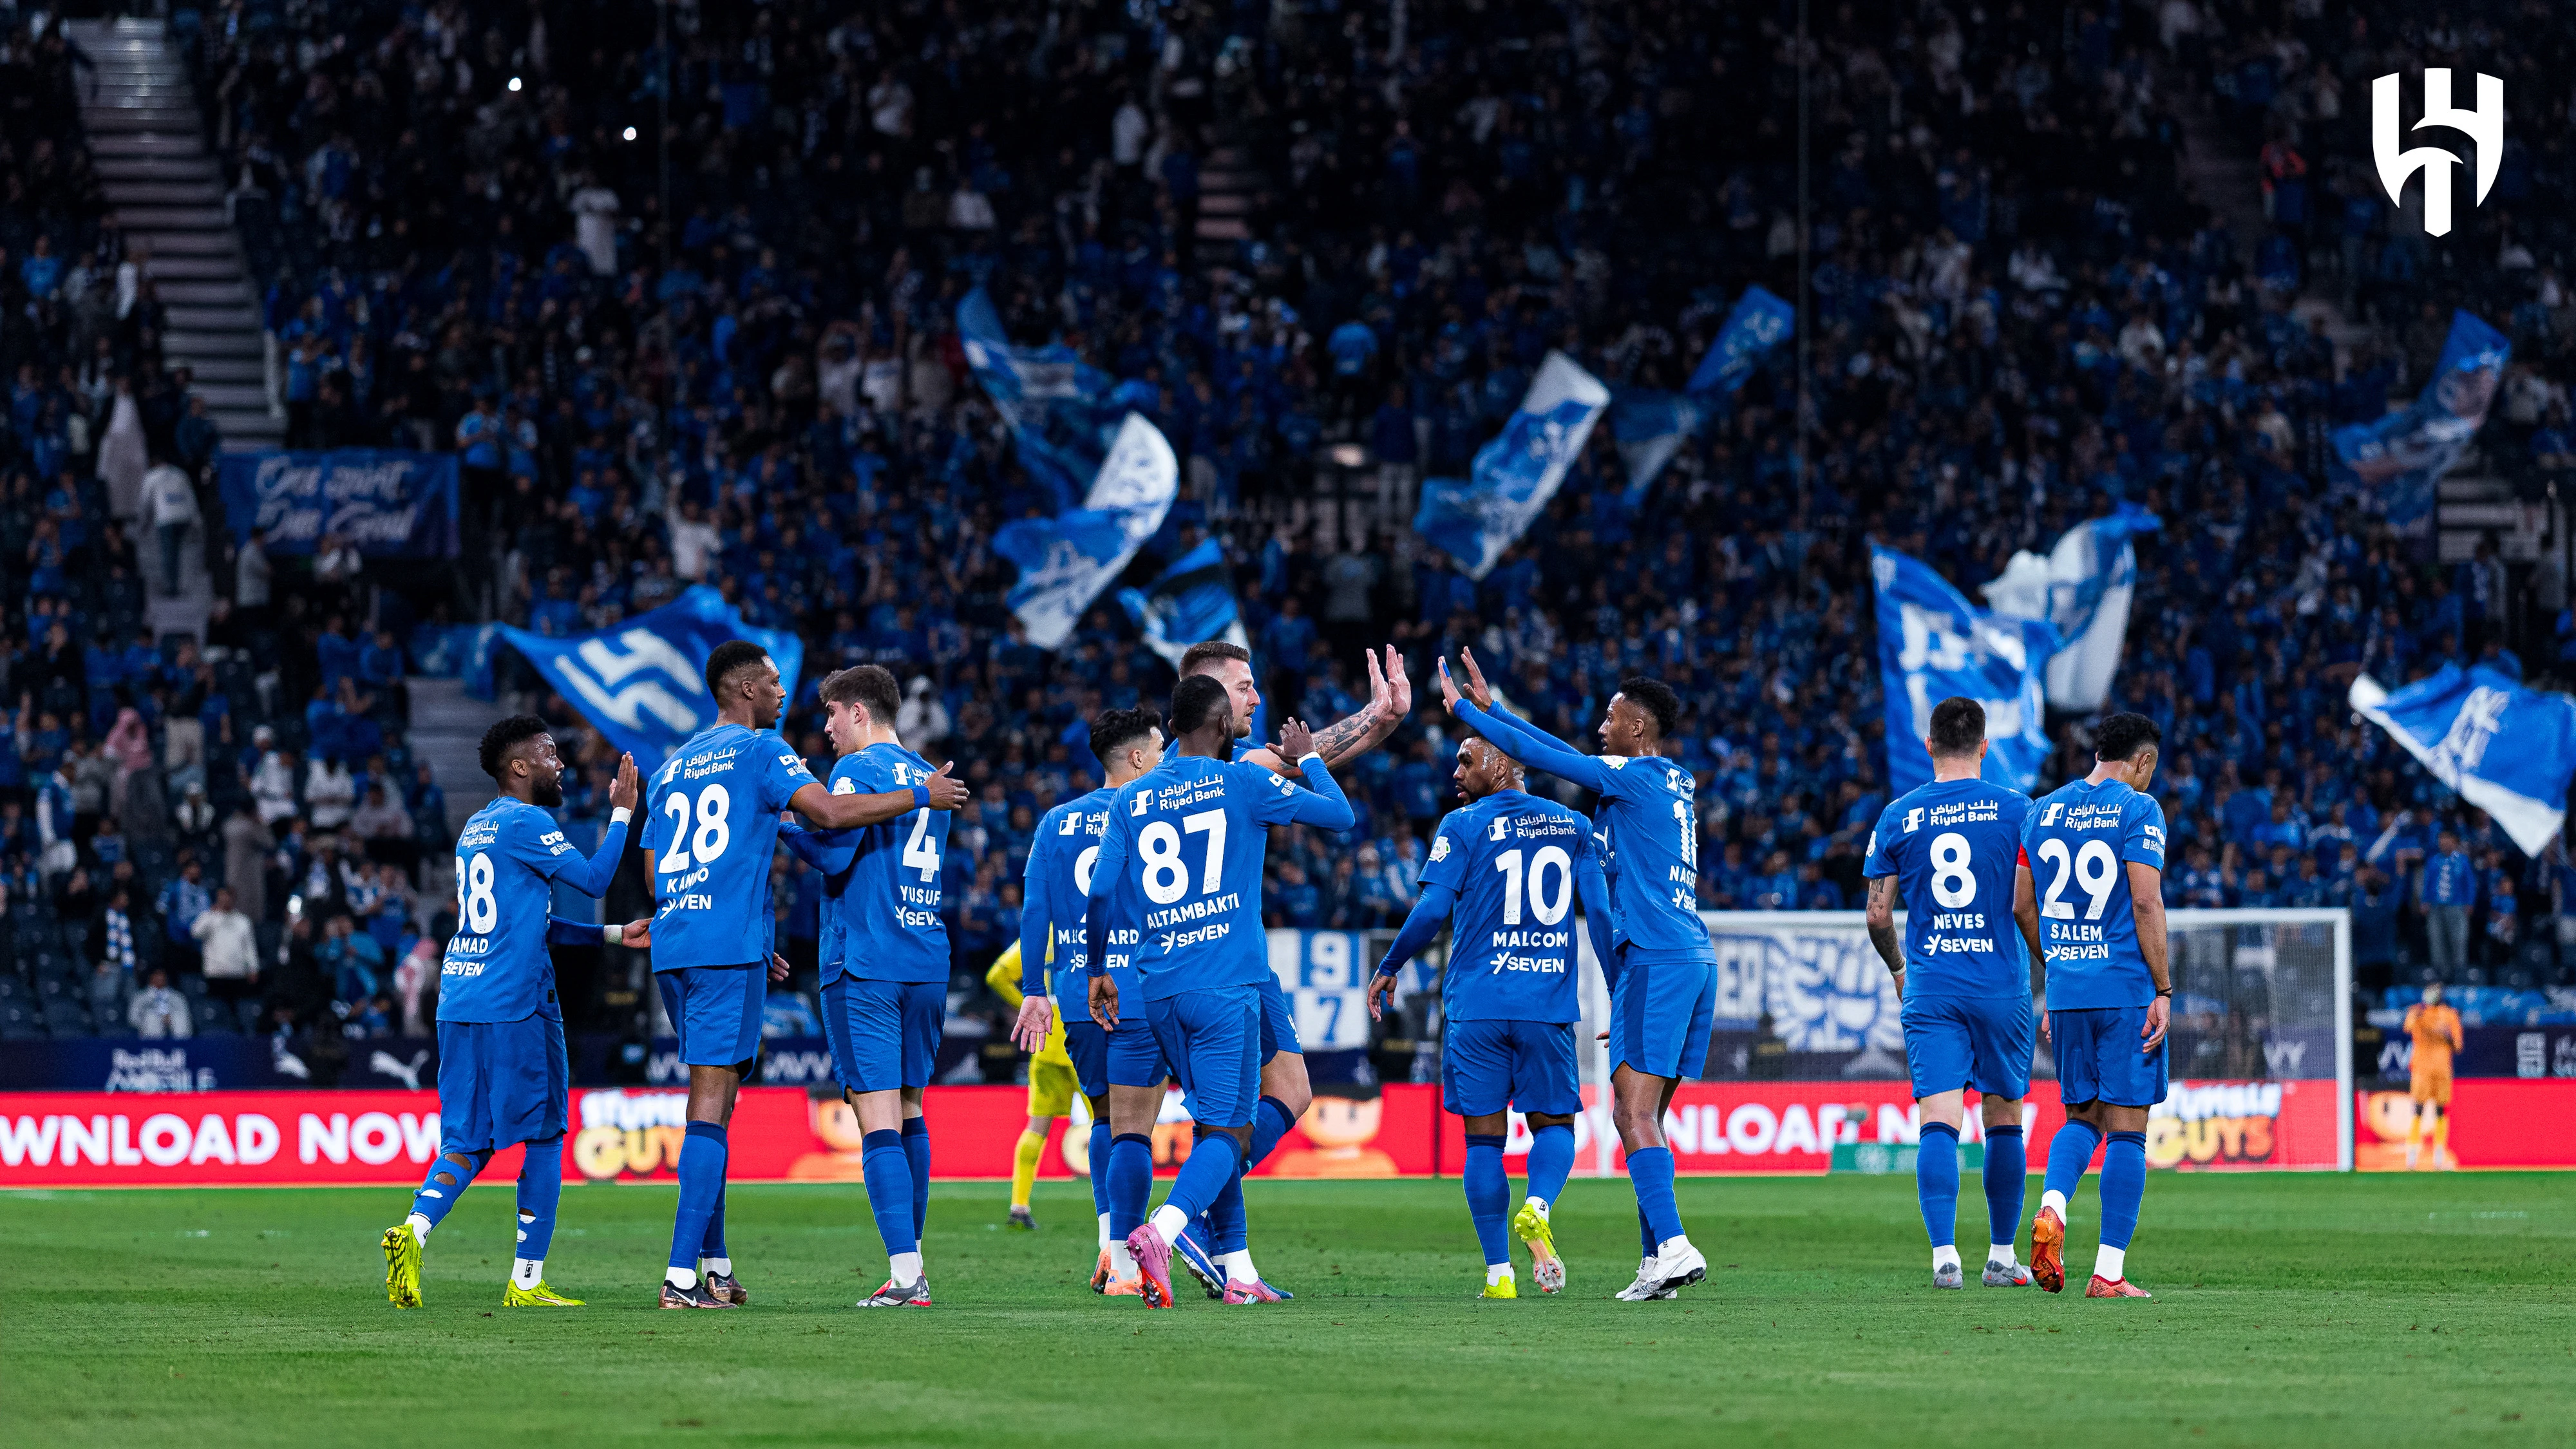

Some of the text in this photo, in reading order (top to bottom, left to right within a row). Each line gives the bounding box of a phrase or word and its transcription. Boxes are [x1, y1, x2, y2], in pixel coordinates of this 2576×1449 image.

[684, 760, 734, 780] Riyad Bank
[1159, 786, 1225, 811] Riyad Bank
[658, 783, 730, 873] 28
[1930, 811, 1998, 826] Riyad Bank
[2065, 817, 2119, 831] Riyad Bank
[1517, 825, 1577, 838] Riyad Bank
[903, 807, 940, 882] 4
[1138, 808, 1227, 904] 87
[1930, 833, 1976, 908] 8
[2037, 838, 2117, 920] 29
[1495, 846, 1571, 925] 10
[674, 894, 712, 909] VEN
[900, 886, 941, 905] YUSUF
[905, 911, 943, 926] SEV
[1147, 893, 1240, 929] ALTAMBAKTI
[1933, 914, 1985, 929] NEVES
[1177, 923, 1229, 947] SEVEN
[1493, 932, 1568, 947] MALCOM
[2050, 923, 2102, 942] SALEM
[1940, 938, 1993, 952] SEVEN
[2060, 943, 2108, 961] SEVEN
[442, 961, 486, 976] SEVEN
[1075, 954, 1129, 968] SEN
[1310, 931, 1350, 987] 9
[1507, 957, 1564, 972] SEVEN
[1317, 996, 1341, 1042] 7
[574, 1126, 685, 1179] GUY
